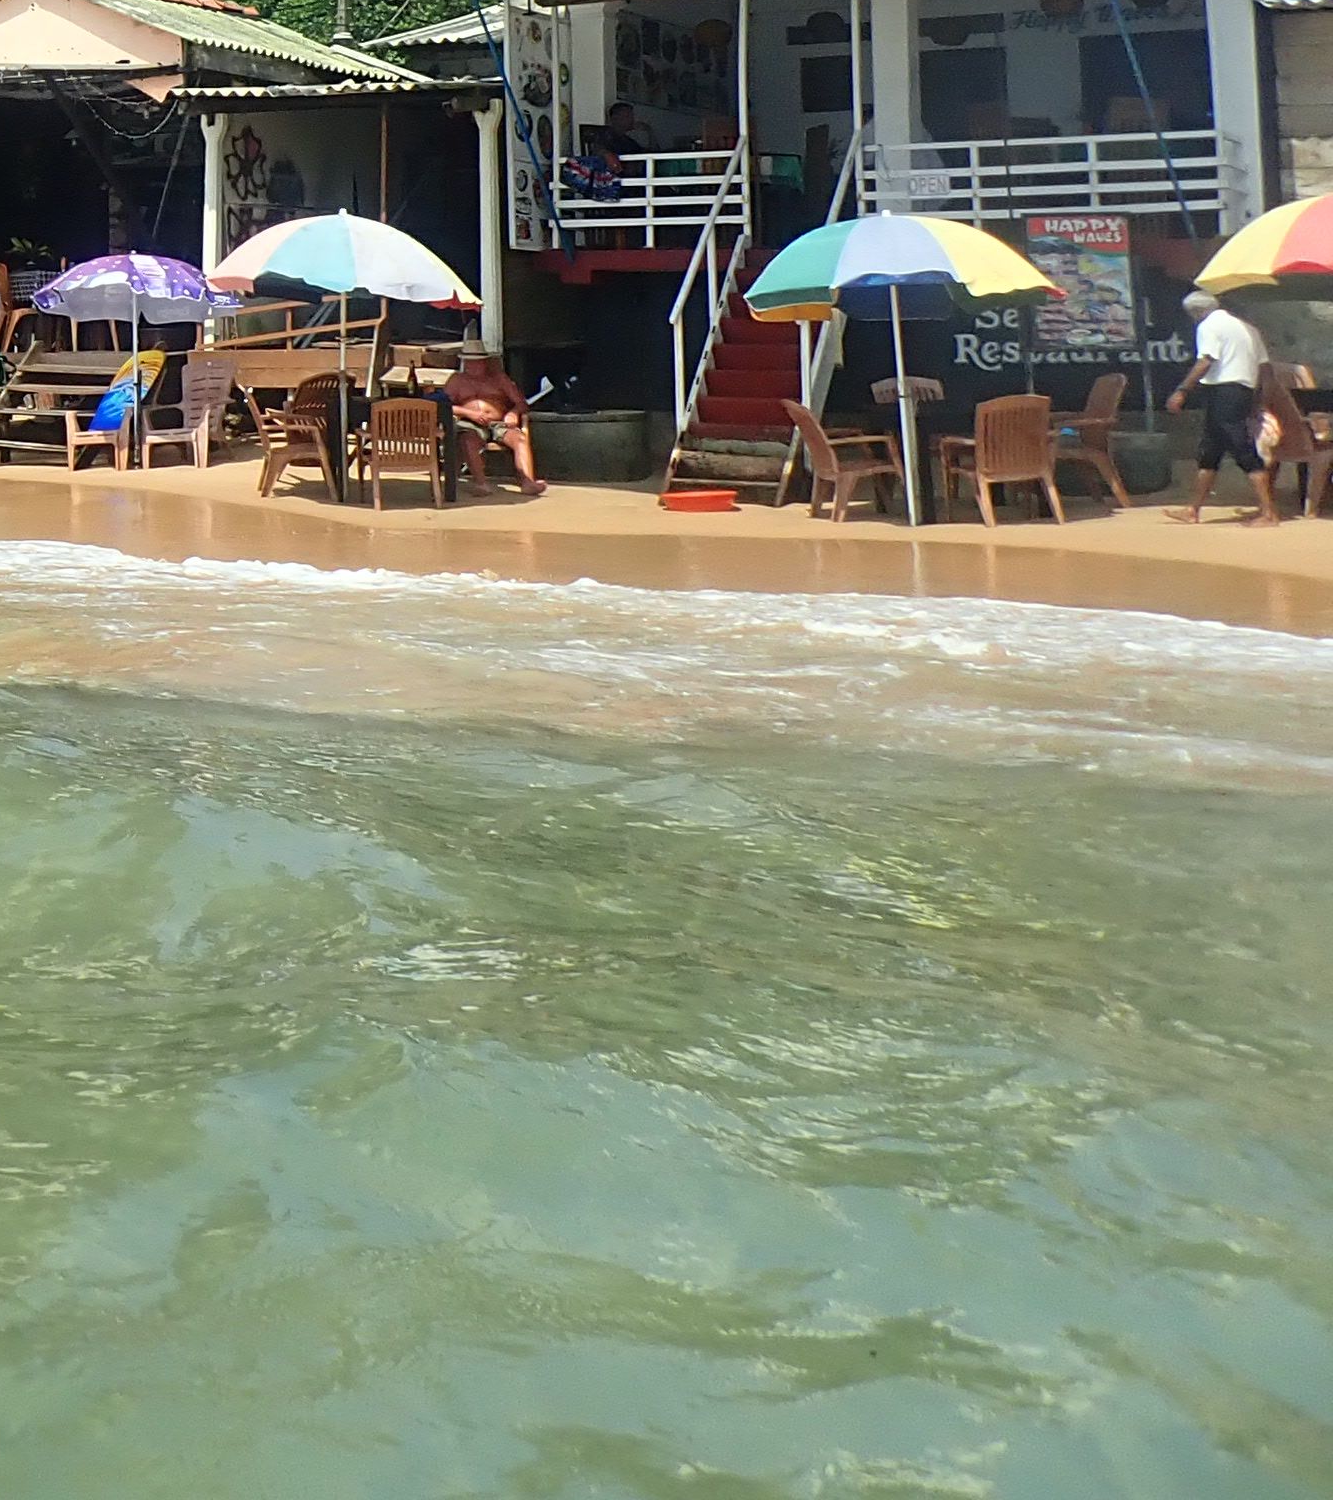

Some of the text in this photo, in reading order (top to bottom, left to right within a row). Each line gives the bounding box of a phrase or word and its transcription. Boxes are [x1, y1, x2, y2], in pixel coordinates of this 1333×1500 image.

[908, 177, 948, 194] OPEN
[1044, 217, 1124, 233] HAPPY
[1073, 232, 1122, 243] WAVES
[953, 331, 1191, 372] Resant
